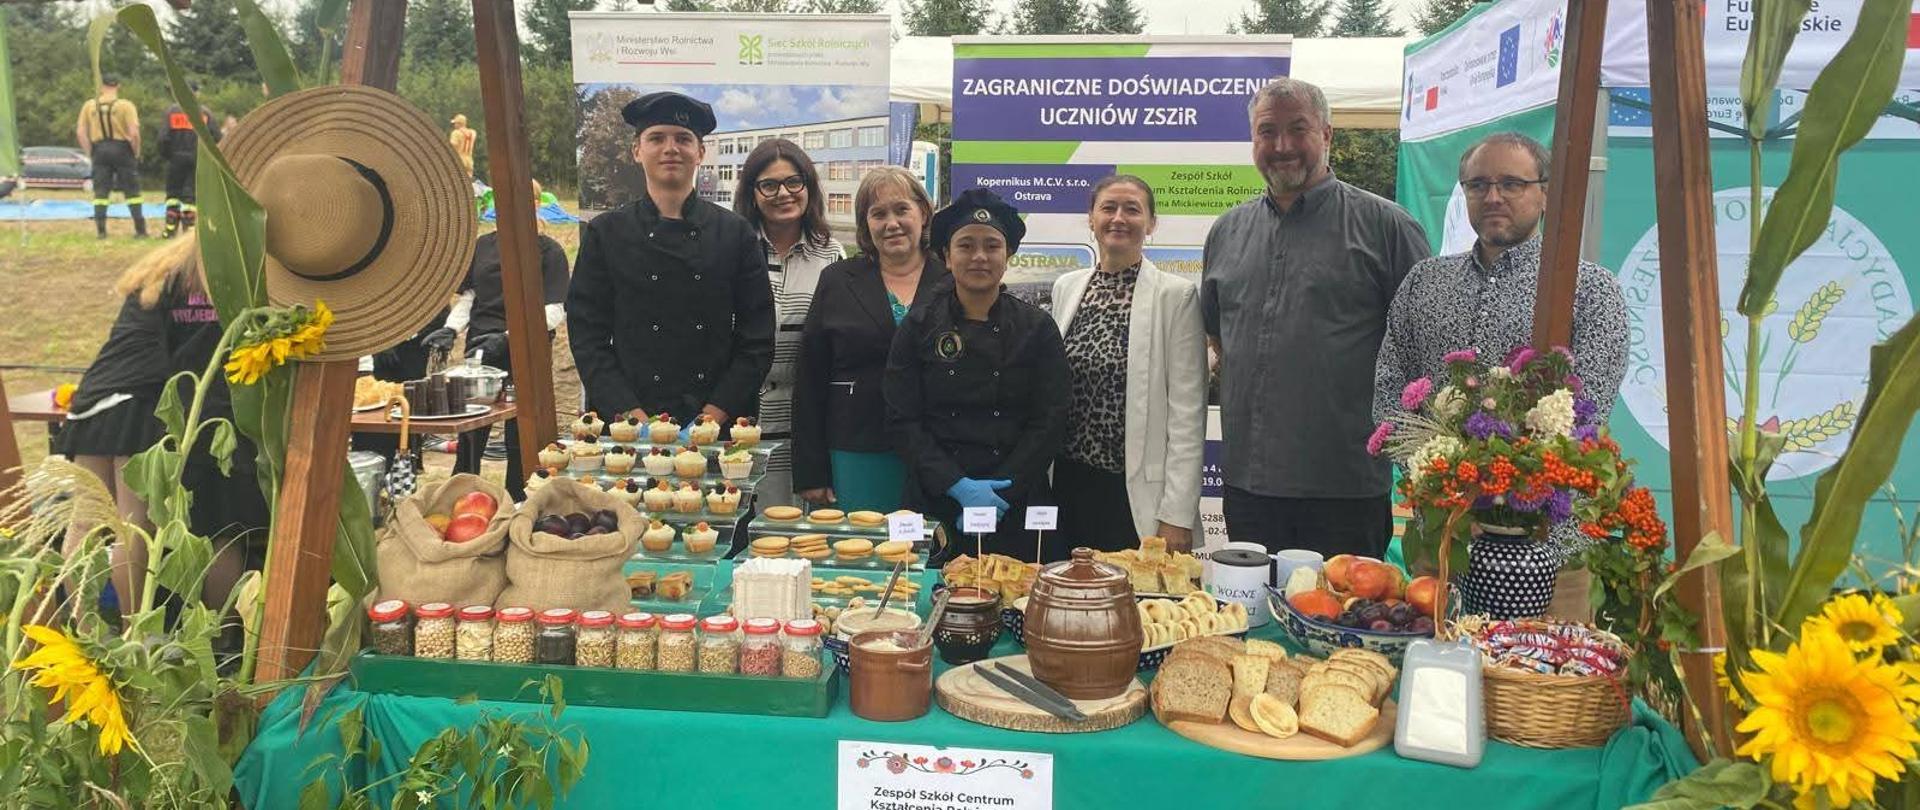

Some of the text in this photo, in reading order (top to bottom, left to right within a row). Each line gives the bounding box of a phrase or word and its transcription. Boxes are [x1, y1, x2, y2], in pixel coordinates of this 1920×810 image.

[621, 46, 658, 56] Rozwoju
[962, 78, 1102, 96] ZAGRANICZNE
[1040, 103, 1198, 125] UCZNIÓW ZSZiR
[1206, 171, 1232, 181] Szkół
[976, 176, 1090, 188] Kopernikus M.C.V. s.r.o.
[1014, 191, 1052, 201] Ostrava
[1168, 186, 1225, 196] Kształcenia
[1171, 199, 1223, 208] Mickiewicza
[874, 786, 1014, 806] Zespół Szkół Centrum
